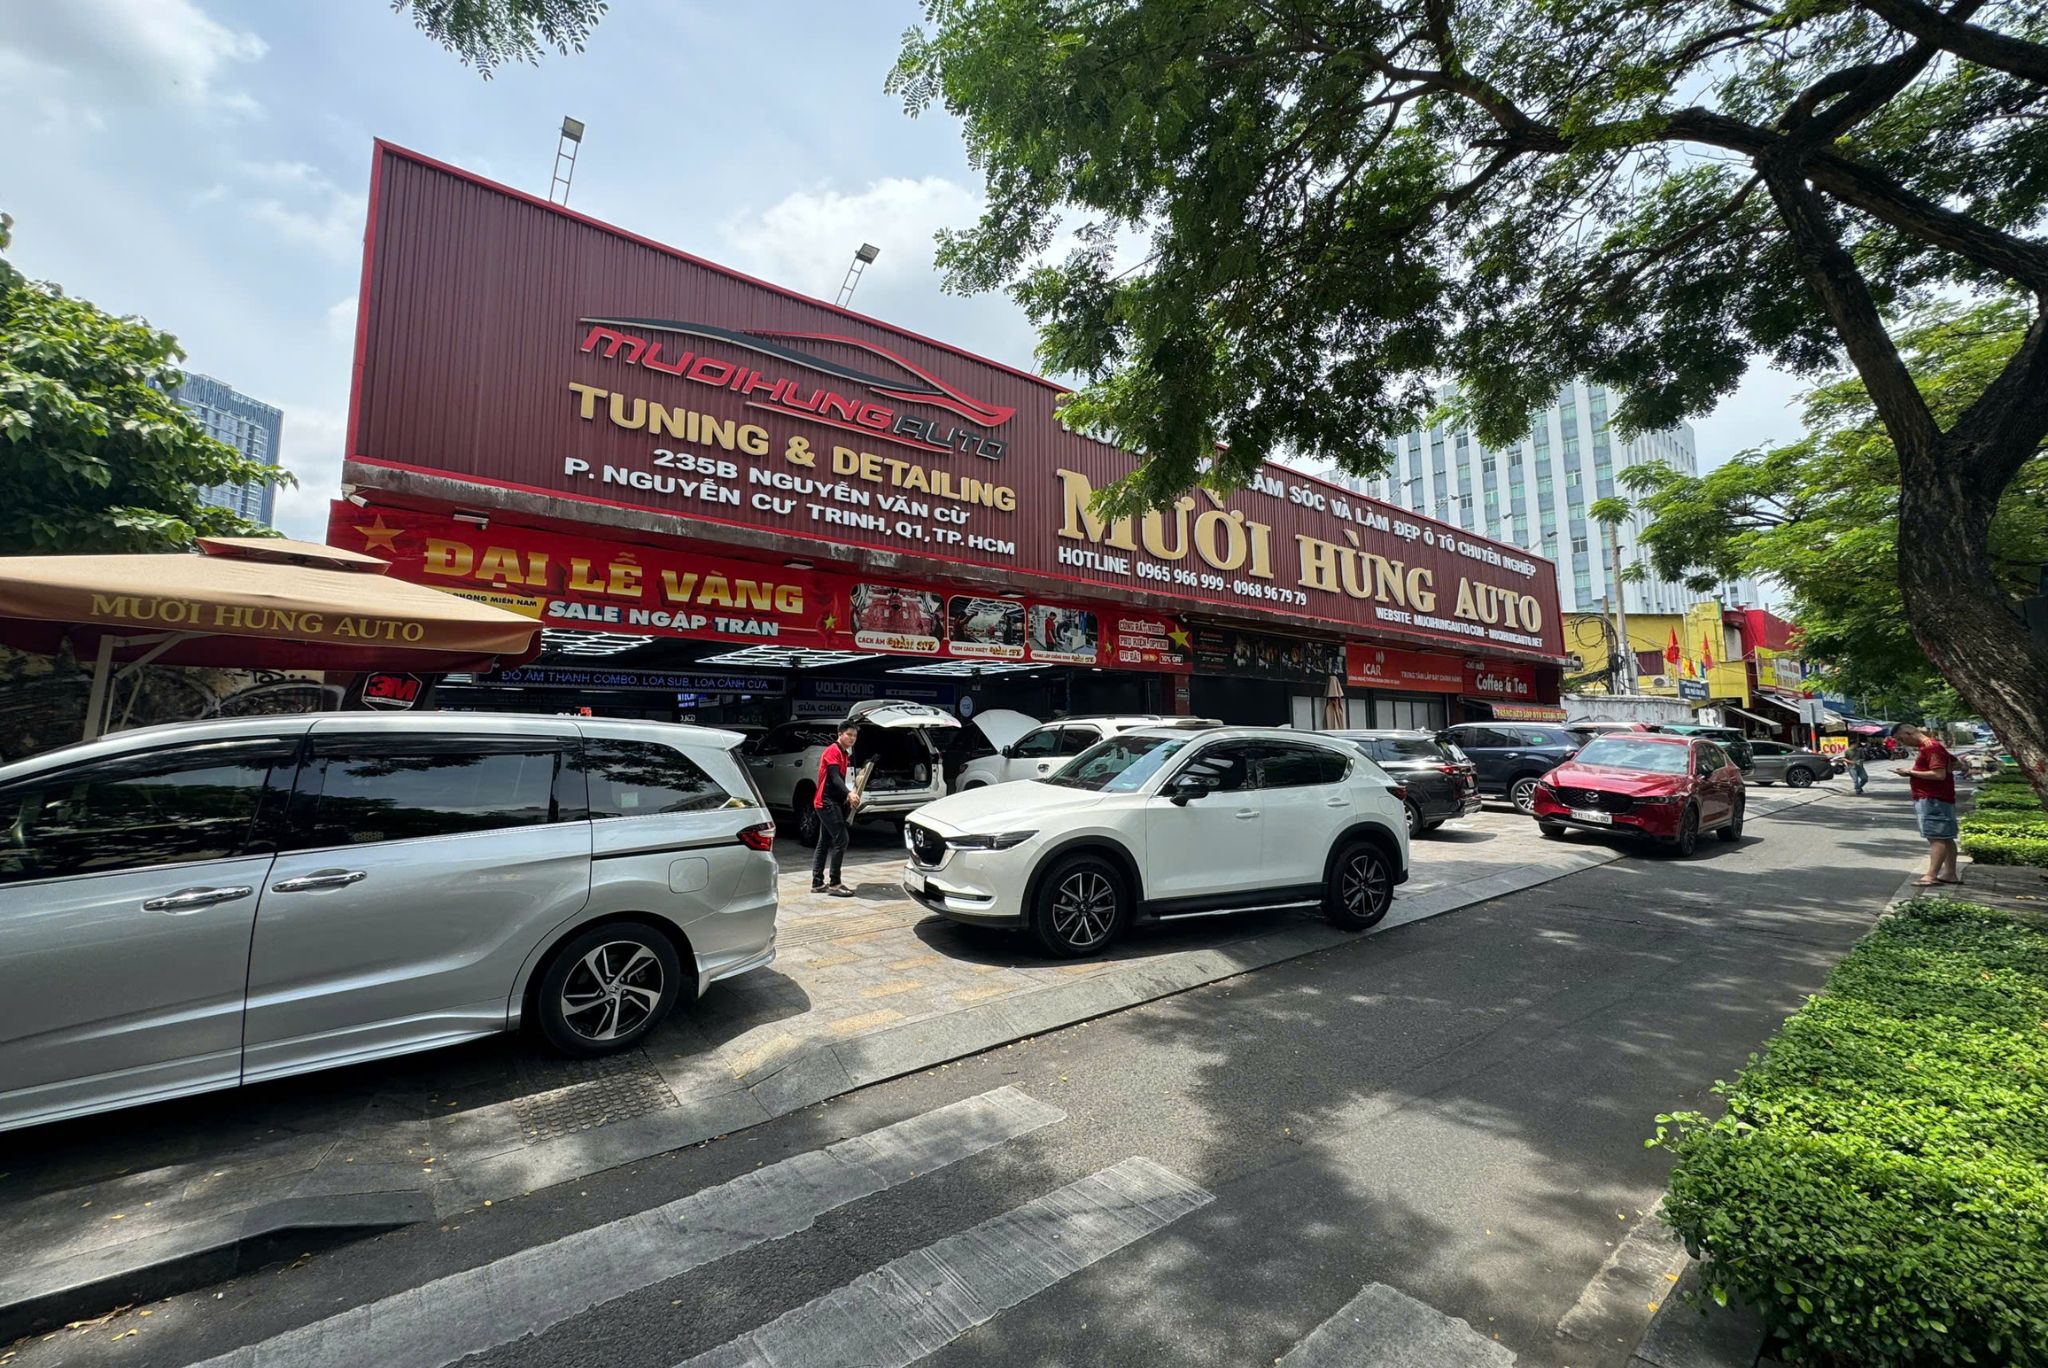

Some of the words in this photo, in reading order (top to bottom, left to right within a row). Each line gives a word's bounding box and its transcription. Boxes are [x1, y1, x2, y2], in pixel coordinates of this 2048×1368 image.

[568, 382, 769, 455] TUNING
[785, 435, 816, 467] &
[833, 446, 1016, 512] DETAILING
[564, 457, 595, 479] P.
[602, 464, 740, 506] NGUYỄN
[751, 493, 797, 515] CƯ
[653, 449, 738, 479] 235B
[749, 466, 870, 507] NGUYỄN
[876, 493, 929, 518] VĂN
[933, 505, 970, 526] CỪ
[1288, 484, 1326, 512] SÓC
[1329, 497, 1352, 521] VÀ
[1355, 506, 1390, 533] LÀM
[1392, 519, 1421, 543] ĐẸP
[1423, 527, 1435, 545] Ô
[1437, 534, 1456, 552] TÔ
[1457, 541, 1502, 567] CHUYÊN
[1502, 555, 1537, 579] NGHIỆP
[1056, 469, 1274, 579] MƯỜI
[1295, 528, 1436, 613] HÙNG
[1454, 577, 1542, 633] AUTO
[423, 537, 549, 589] ĐẠI
[568, 551, 643, 597] LỄ
[660, 569, 804, 614] VÀNG
[1136, 561, 1170, 582] 0965
[1173, 568, 1198, 587] 966
[1200, 574, 1224, 591] 999
[1233, 579, 1262, 598] 0968
[516, 599, 538, 608] NAM
[547, 600, 619, 623] SALE
[628, 608, 707, 632] NGẬP
[714, 617, 779, 636] TRÀN
[333, 617, 425, 642] AUTO
[524, 670, 545, 681] ÂM
[547, 671, 590, 683] THANH
[642, 676, 666, 686] LOA
[694, 678, 716, 688] LOA
[1363, 662, 1382, 677] ICAR
[1476, 673, 1503, 692] Coffee
[1505, 676, 1512, 693] &
[1514, 677, 1527, 694] Tea
[367, 675, 418, 702] 3M
